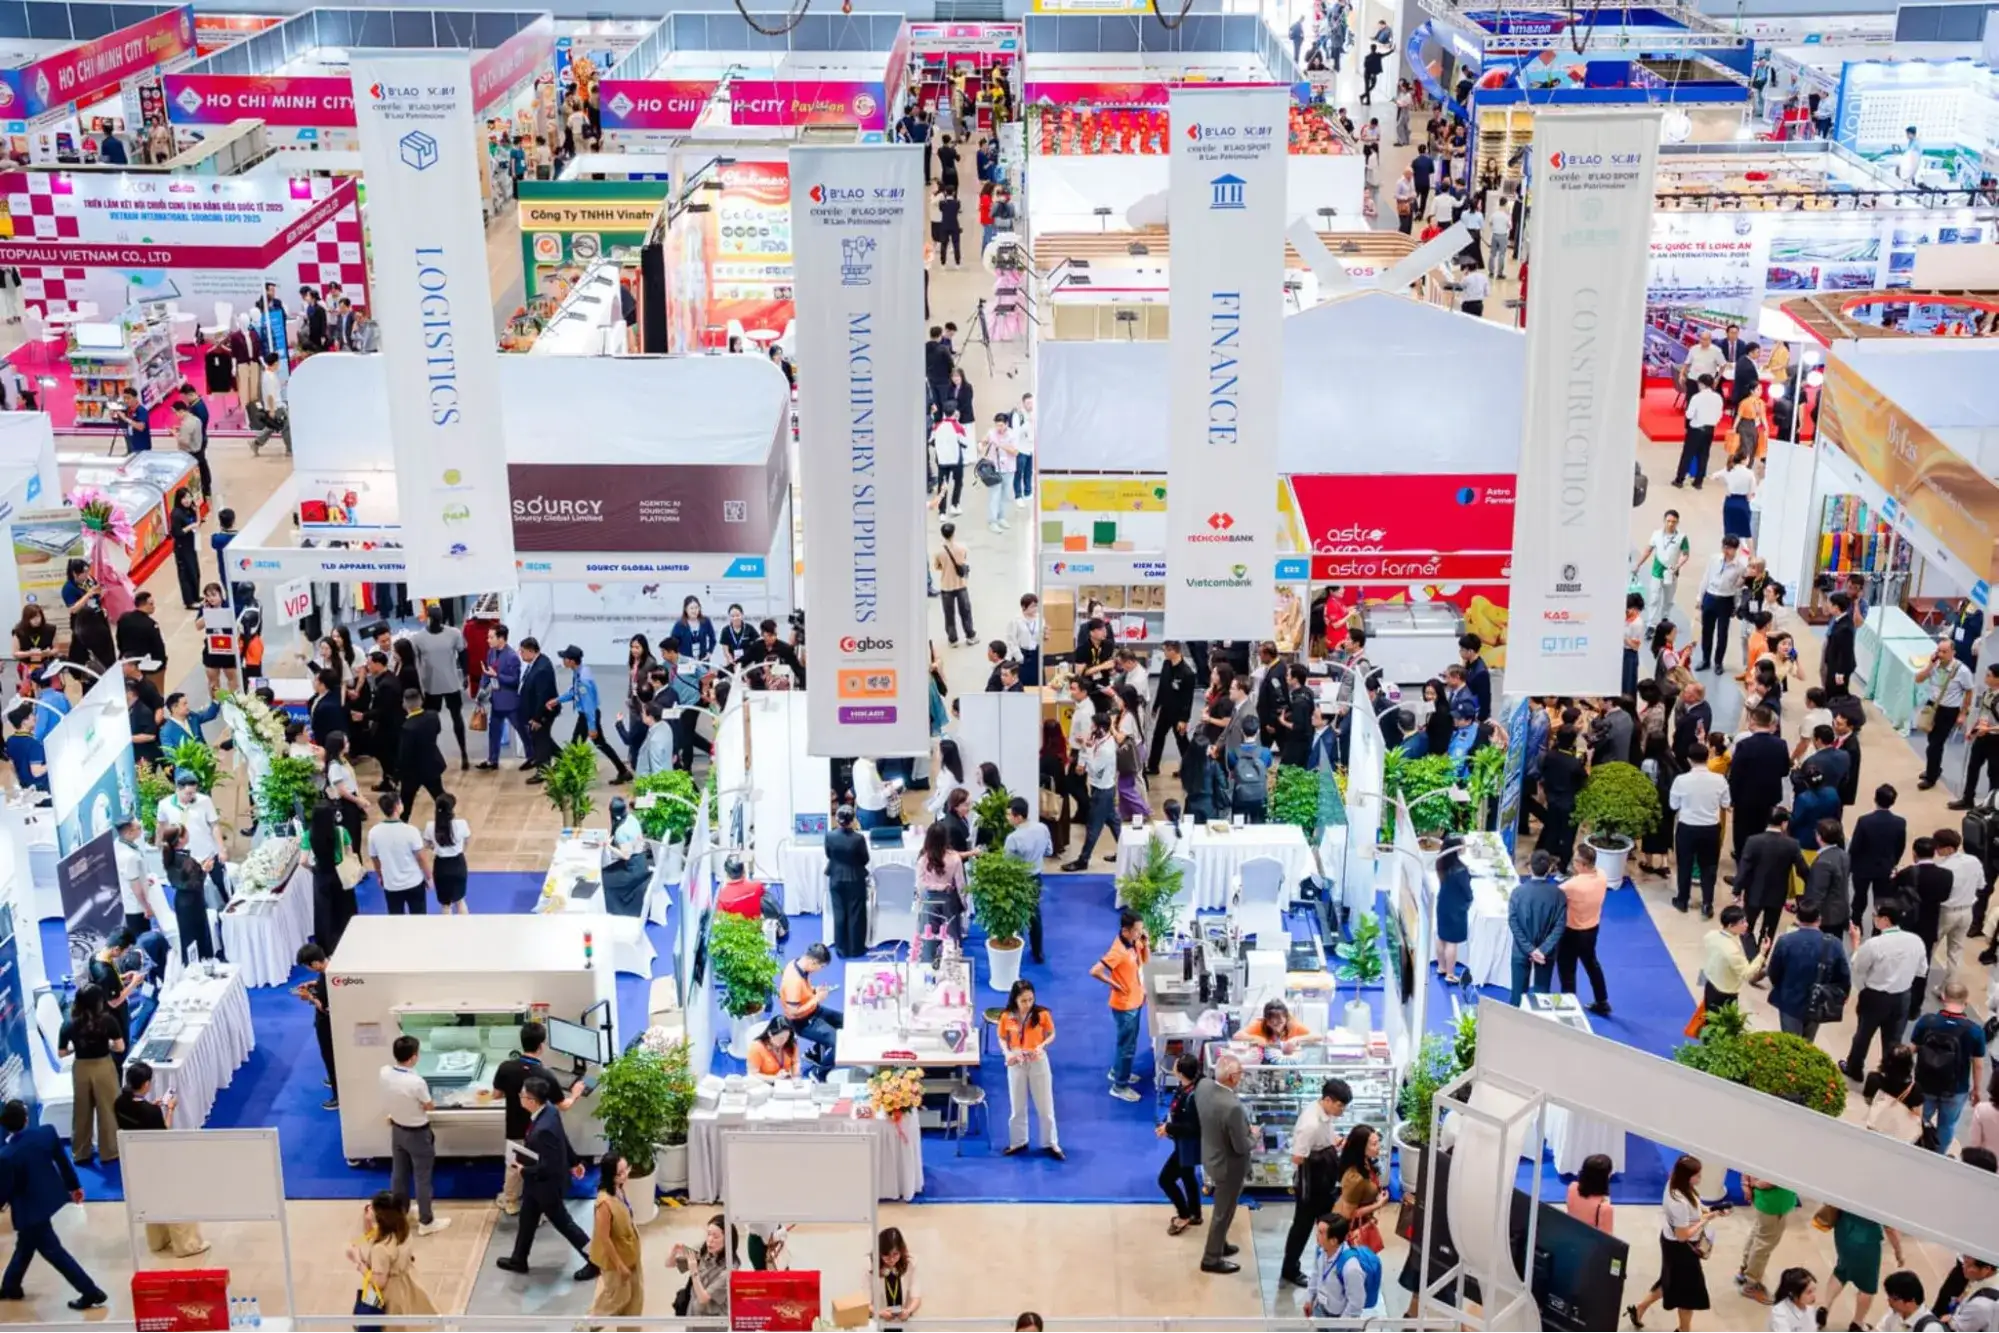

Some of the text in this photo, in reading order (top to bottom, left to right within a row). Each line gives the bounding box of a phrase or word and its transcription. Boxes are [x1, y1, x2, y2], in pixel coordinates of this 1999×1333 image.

[1508, 25, 1550, 34] amazon
[58, 67, 74, 91] HO
[76, 59, 96, 83] CHI
[97, 47, 123, 74] MINH
[124, 38, 143, 64] CITY
[206, 94, 232, 108] HO
[237, 95, 265, 109] CHI
[272, 96, 316, 109] MINH
[637, 99, 662, 112] HO
[668, 99, 695, 112] CHI
[750, 99, 785, 113] CITY
[830, 188, 864, 198] B'LAO
[110, 211, 139, 220] VIETNAM
[141, 211, 189, 221] INTERNATIONAL
[530, 209, 561, 222] Công
[563, 209, 577, 222] Ty
[580, 210, 613, 220] TNHH
[878, 207, 904, 215] SPORT
[1737, 242, 1752, 250] AN
[0, 249, 171, 264] TOPVALU VIETNAM CO., LTD
[1669, 251, 1727, 259] INTERNATIONAL
[415, 245, 461, 426] LOGISTICS
[1208, 291, 1240, 445] FINANCE
[1561, 287, 1598, 528] CONSTRUCTION
[849, 311, 877, 623] MACHINERY SUPPLIERS
[1486, 487, 1510, 496] Astro
[513, 514, 604, 522] Sourcy Global Limited
[1188, 535, 1254, 543] TECHCOMBANK
[1327, 523, 1386, 542] astro
[587, 564, 690, 572] SOURCY GLOBAL LIMITED
[1328, 555, 1441, 576] astro farmer
[1186, 577, 1252, 588] Vietcombank
[285, 594, 308, 617] VIP
[857, 636, 894, 653] gbos
[342, 976, 365, 986] gbos
